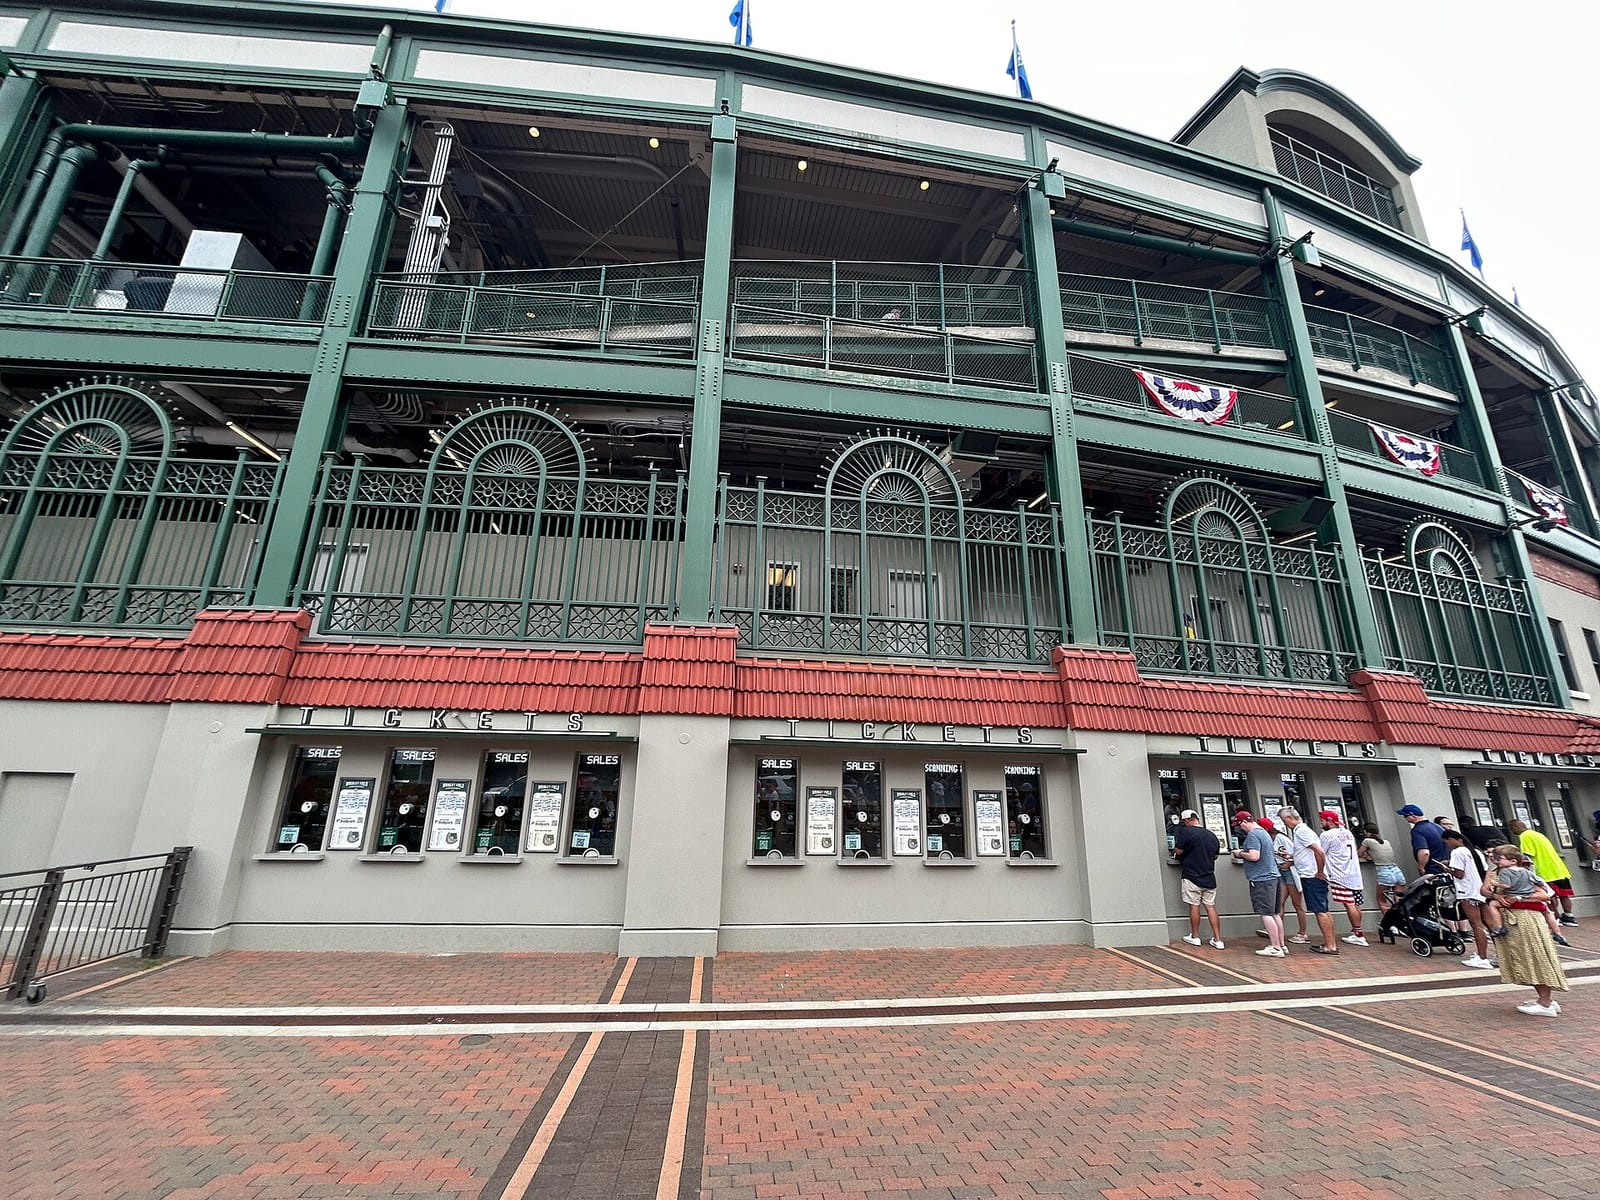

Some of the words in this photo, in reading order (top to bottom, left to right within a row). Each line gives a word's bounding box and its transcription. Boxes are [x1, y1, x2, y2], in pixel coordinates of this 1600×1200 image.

[300, 706, 586, 732] TICKETS
[786, 718, 1034, 744] TICKETS
[1197, 736, 1377, 758] TICKETS
[307, 748, 342, 758] SALES
[402, 751, 435, 761] SALES
[494, 753, 528, 763] SALES
[1482, 748, 1597, 768] TICKETS
[586, 755, 618, 765] SALES
[761, 759, 793, 769] SALES
[846, 761, 875, 771] SALES
[1346, 843, 1353, 860] 7
